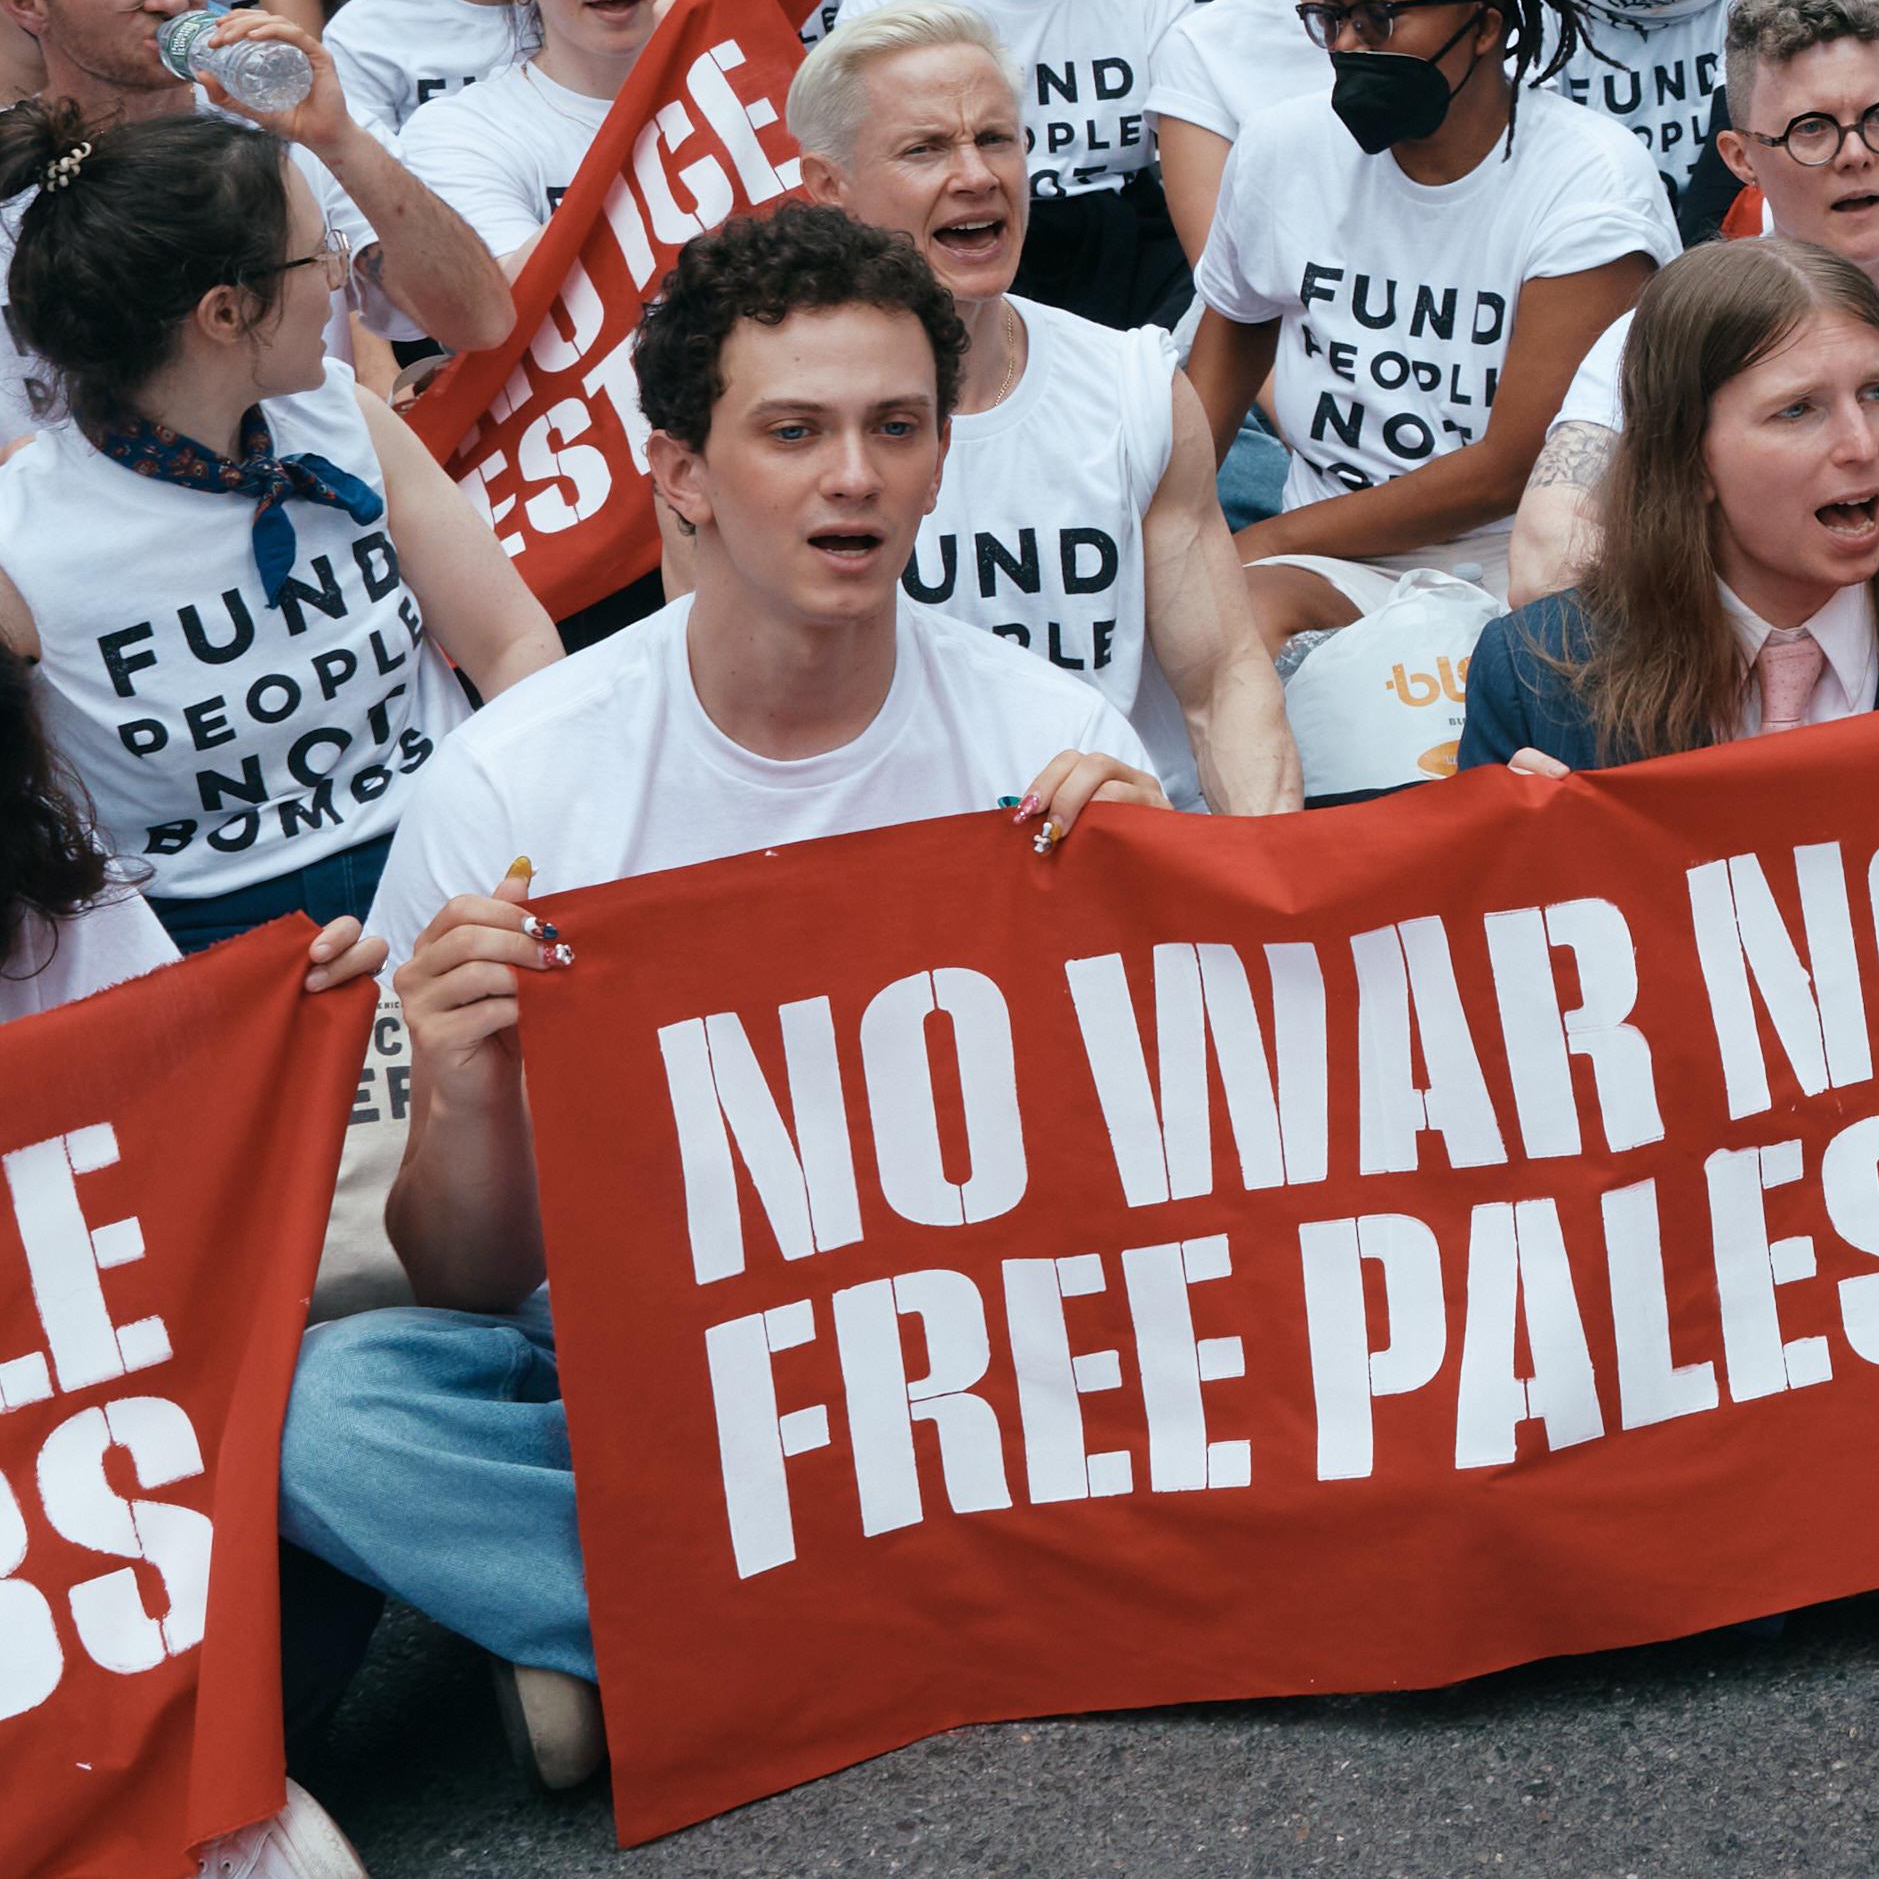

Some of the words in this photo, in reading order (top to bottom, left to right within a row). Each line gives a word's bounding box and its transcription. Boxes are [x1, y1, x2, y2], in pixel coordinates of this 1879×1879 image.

[1299, 261, 1506, 349] FUND
[1302, 322, 1498, 408] PEOPLE
[1310, 387, 1474, 462] NOT
[97, 531, 402, 698] FUND
[116, 595, 424, 759] PEOPLE
[142, 726, 435, 855] BOMBS
[194, 682, 407, 811] NOT
[656, 967, 1029, 1292] NO
[1064, 897, 1666, 1214] WAR
[704, 1231, 1254, 1580] FREE
